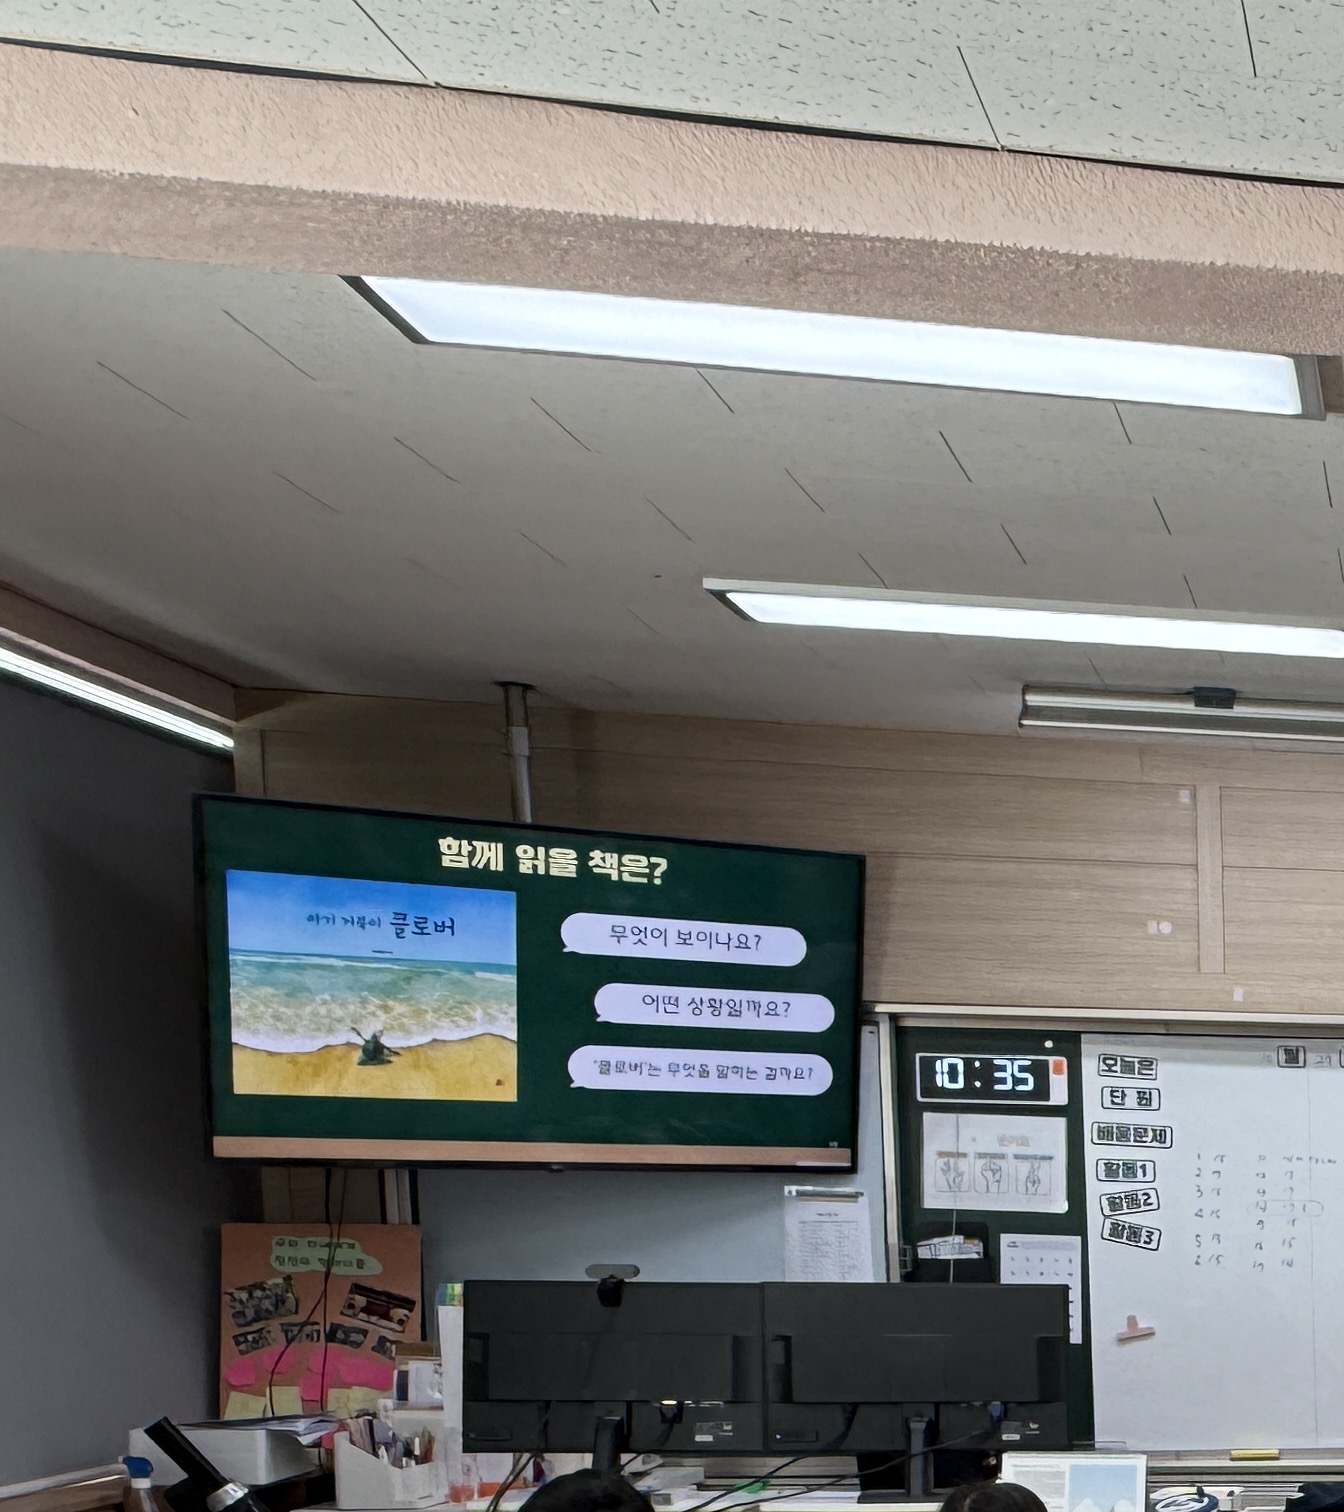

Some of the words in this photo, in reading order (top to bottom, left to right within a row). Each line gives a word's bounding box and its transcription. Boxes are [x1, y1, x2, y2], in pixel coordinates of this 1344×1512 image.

[437, 836, 504, 872] 함께
[515, 843, 579, 878] 읽을
[588, 849, 668, 885] 책은?
[389, 911, 455, 939] 클로버
[609, 924, 668, 948] 무엇이
[675, 928, 763, 952] 보이나요?
[642, 994, 680, 1016] 어떤
[687, 996, 791, 1019] 상황일까요?
[935, 1057, 1035, 1092] 10:35
